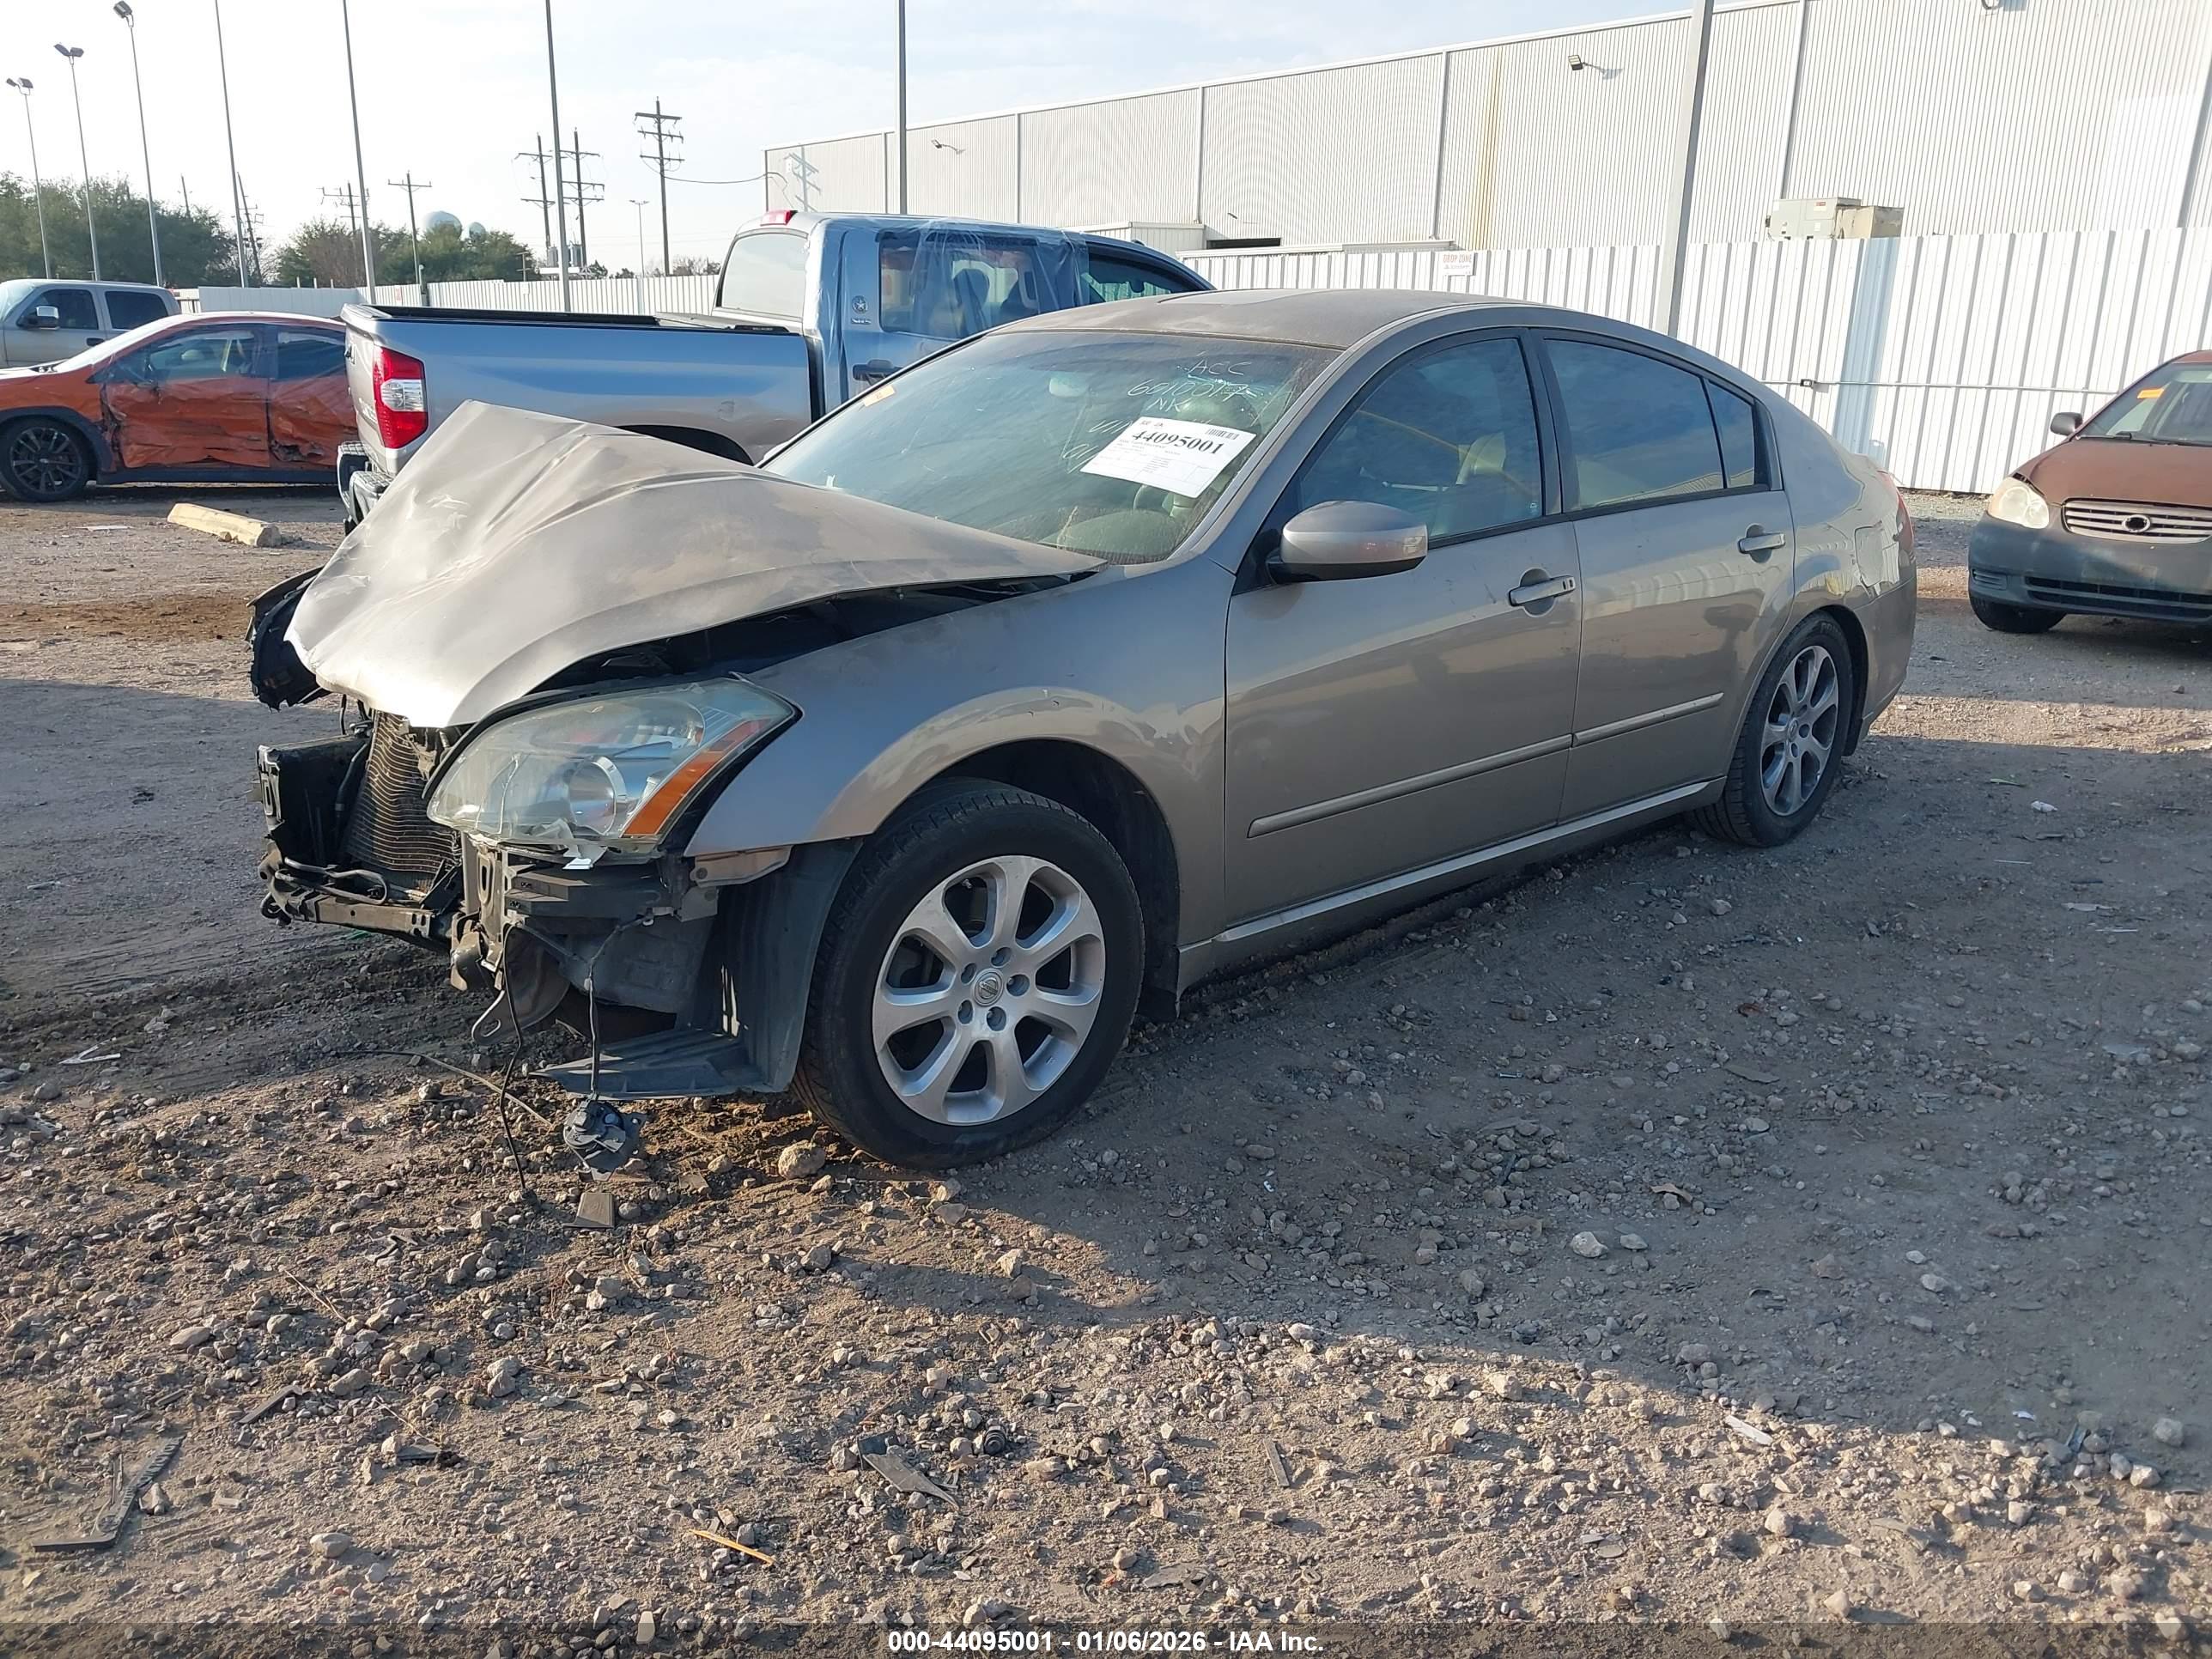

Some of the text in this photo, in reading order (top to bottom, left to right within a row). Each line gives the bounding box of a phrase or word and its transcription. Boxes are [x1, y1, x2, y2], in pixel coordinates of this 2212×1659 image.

[1443, 253, 1458, 263] DROP
[1187, 357, 1252, 375] ACC
[1132, 429, 1225, 454] 44095001
